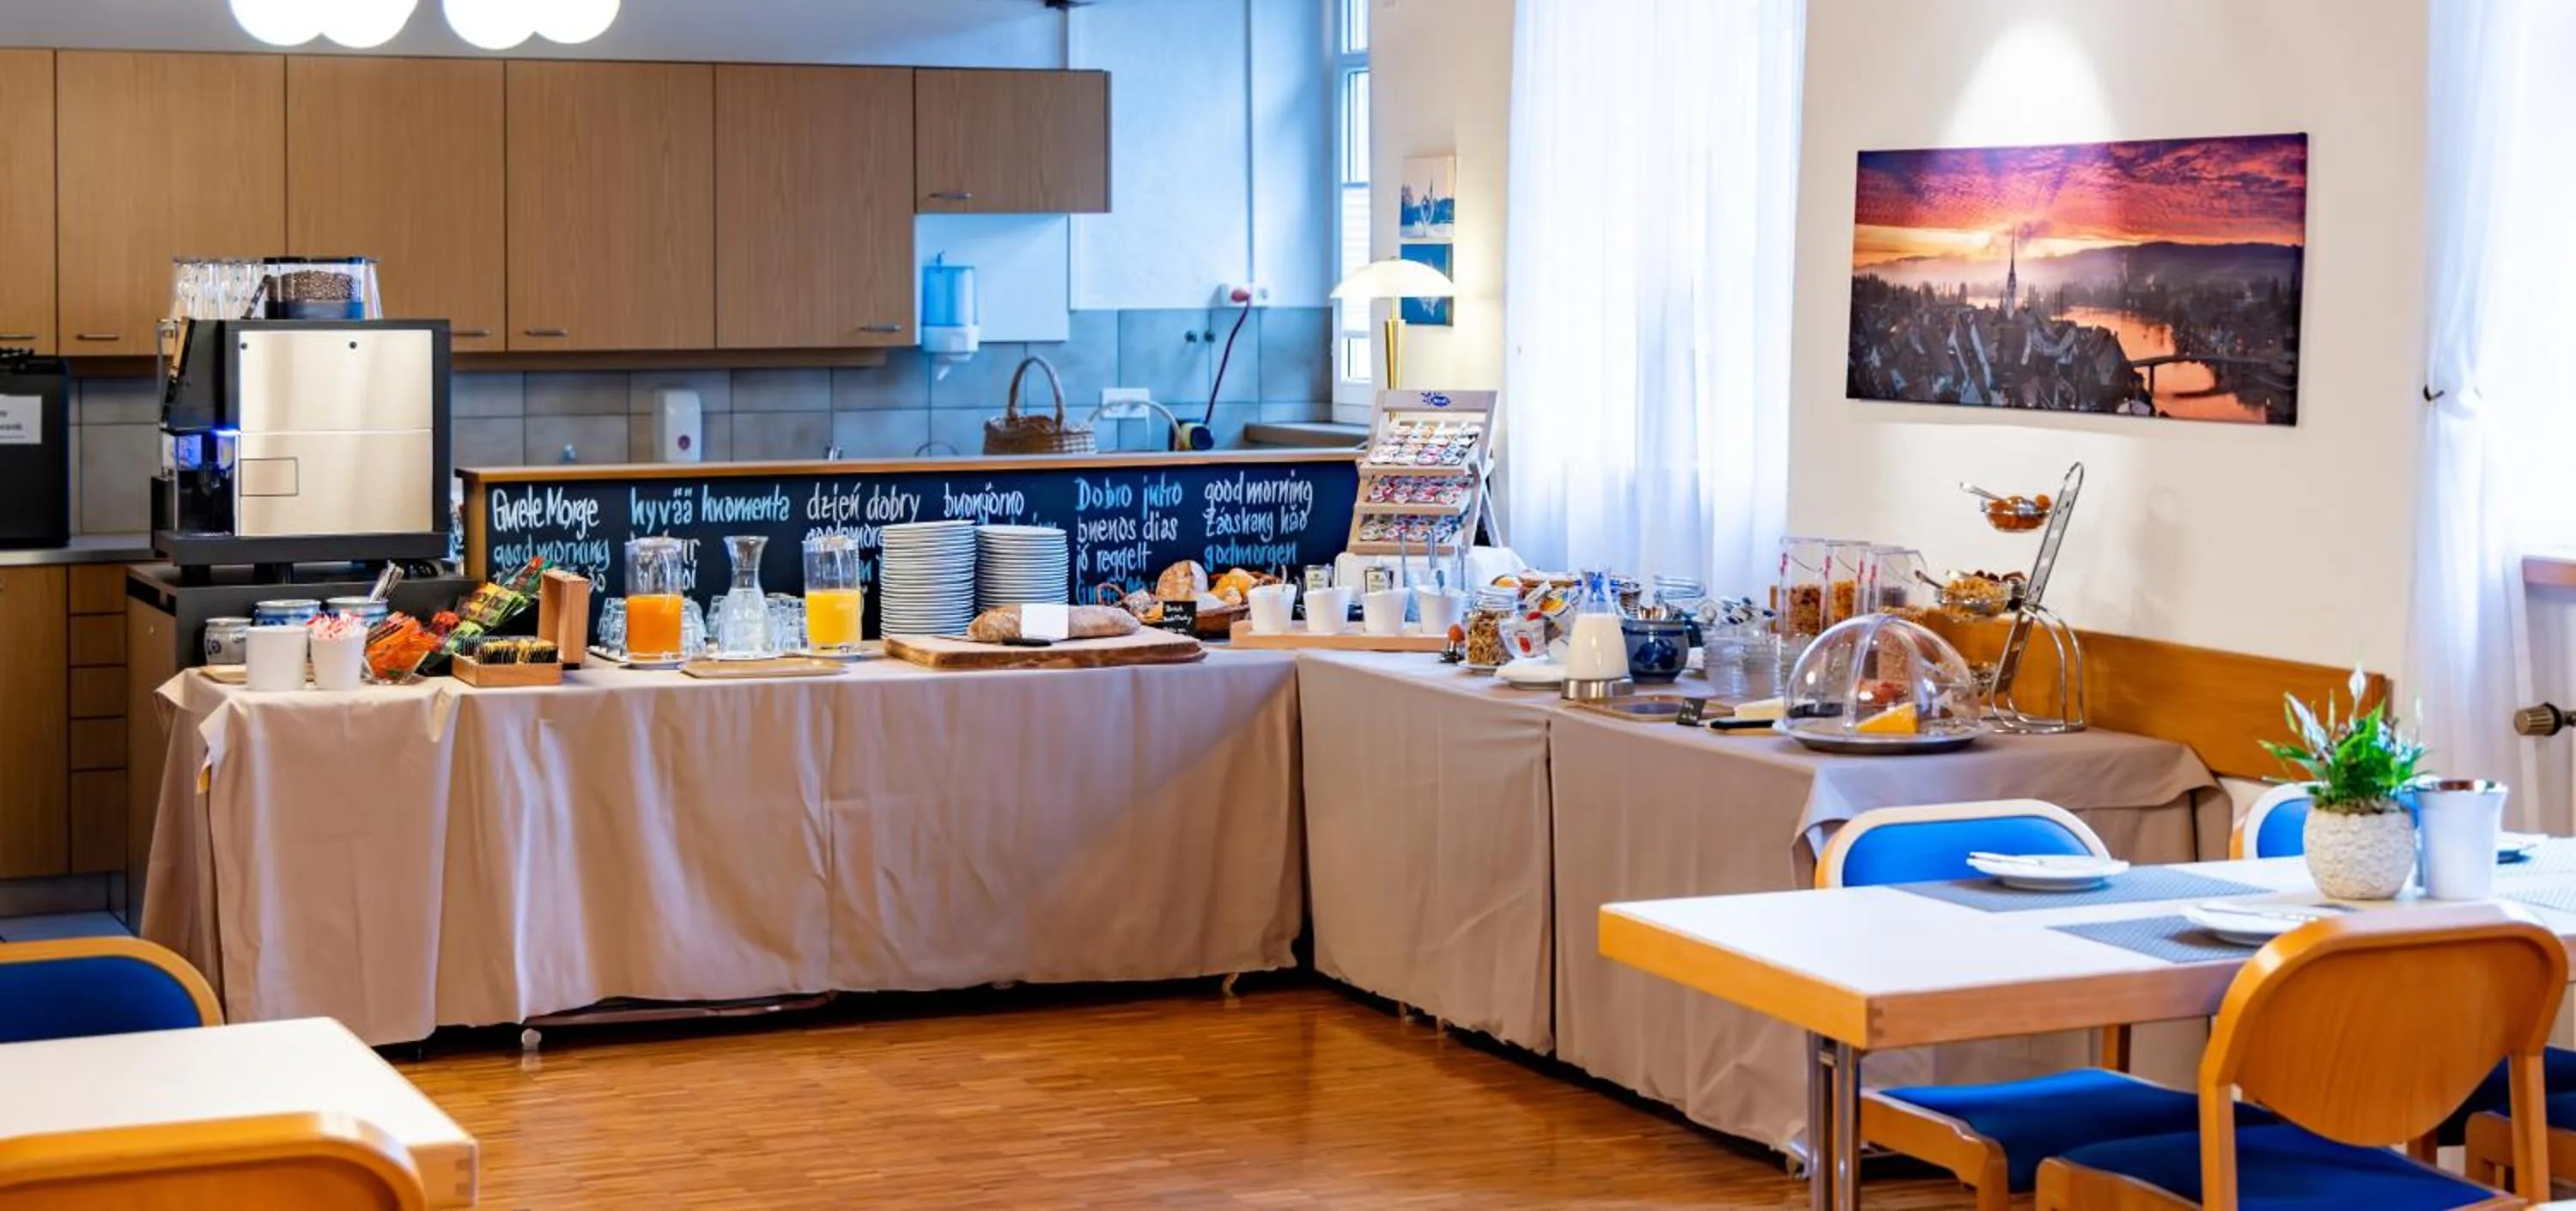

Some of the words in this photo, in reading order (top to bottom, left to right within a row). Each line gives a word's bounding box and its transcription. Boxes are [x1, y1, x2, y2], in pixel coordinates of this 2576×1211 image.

[546, 486, 600, 540] Morge
[631, 486, 692, 534] hyvää
[702, 484, 791, 522] huomenta
[807, 481, 861, 521] dzień
[866, 484, 921, 523] dobry
[1074, 477, 1132, 511] Dobro
[1143, 472, 1182, 520] jutro
[1204, 471, 1244, 513] good
[1246, 469, 1313, 516] morning
[1077, 515, 1136, 544] buenos
[1097, 540, 1153, 582] reggelt
